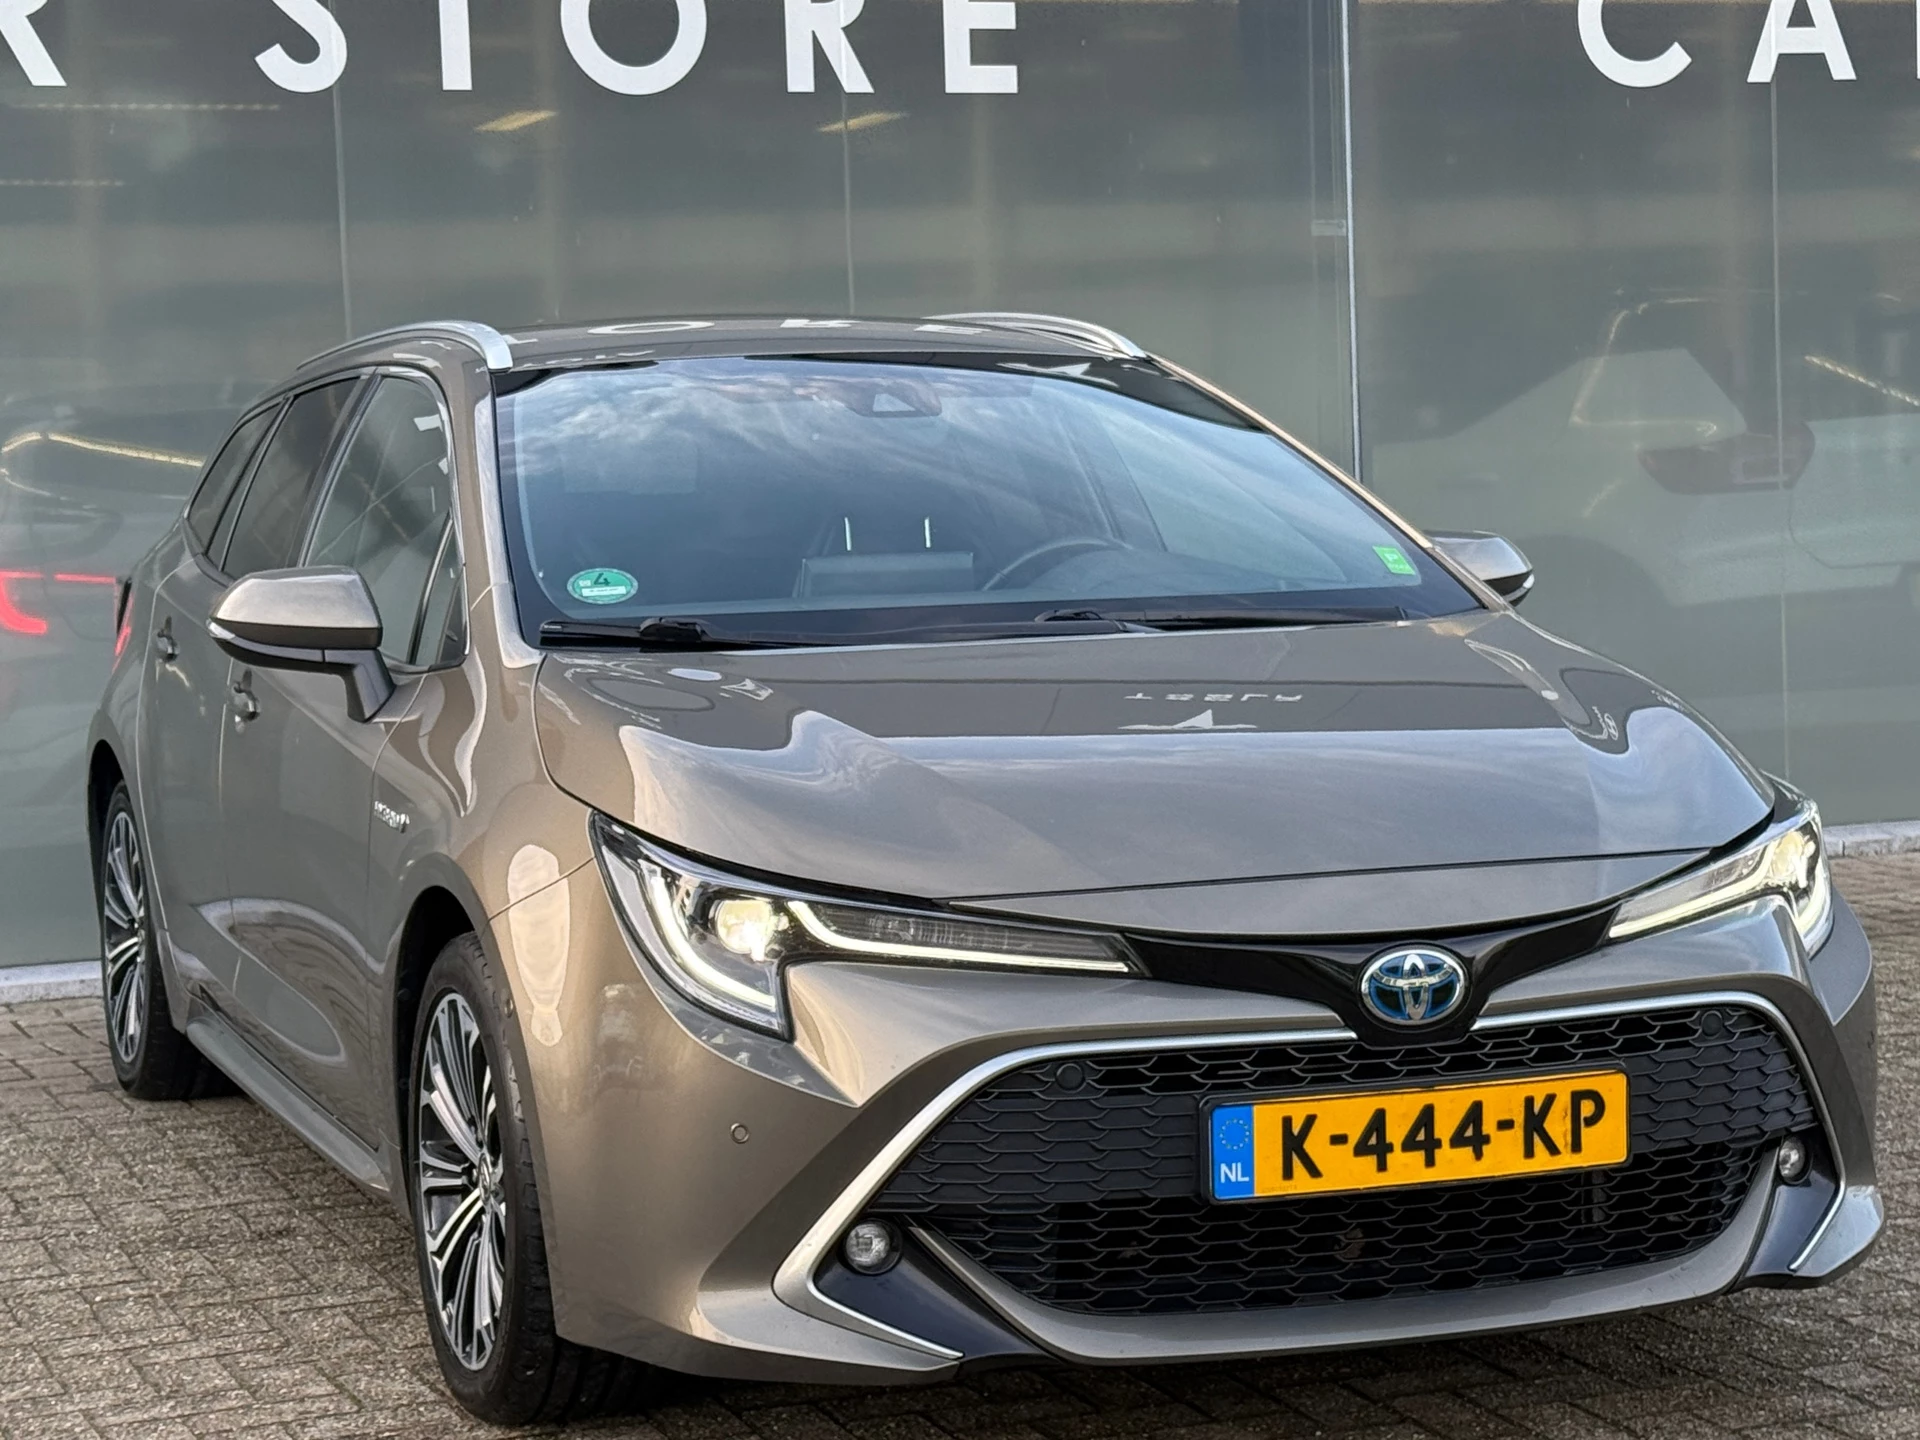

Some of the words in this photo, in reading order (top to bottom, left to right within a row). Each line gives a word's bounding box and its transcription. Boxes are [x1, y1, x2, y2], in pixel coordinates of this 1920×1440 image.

[1578, 0, 1920, 87] CA
[1220, 1162, 1250, 1184] NL
[1281, 1089, 1606, 1181] K-444-KP
